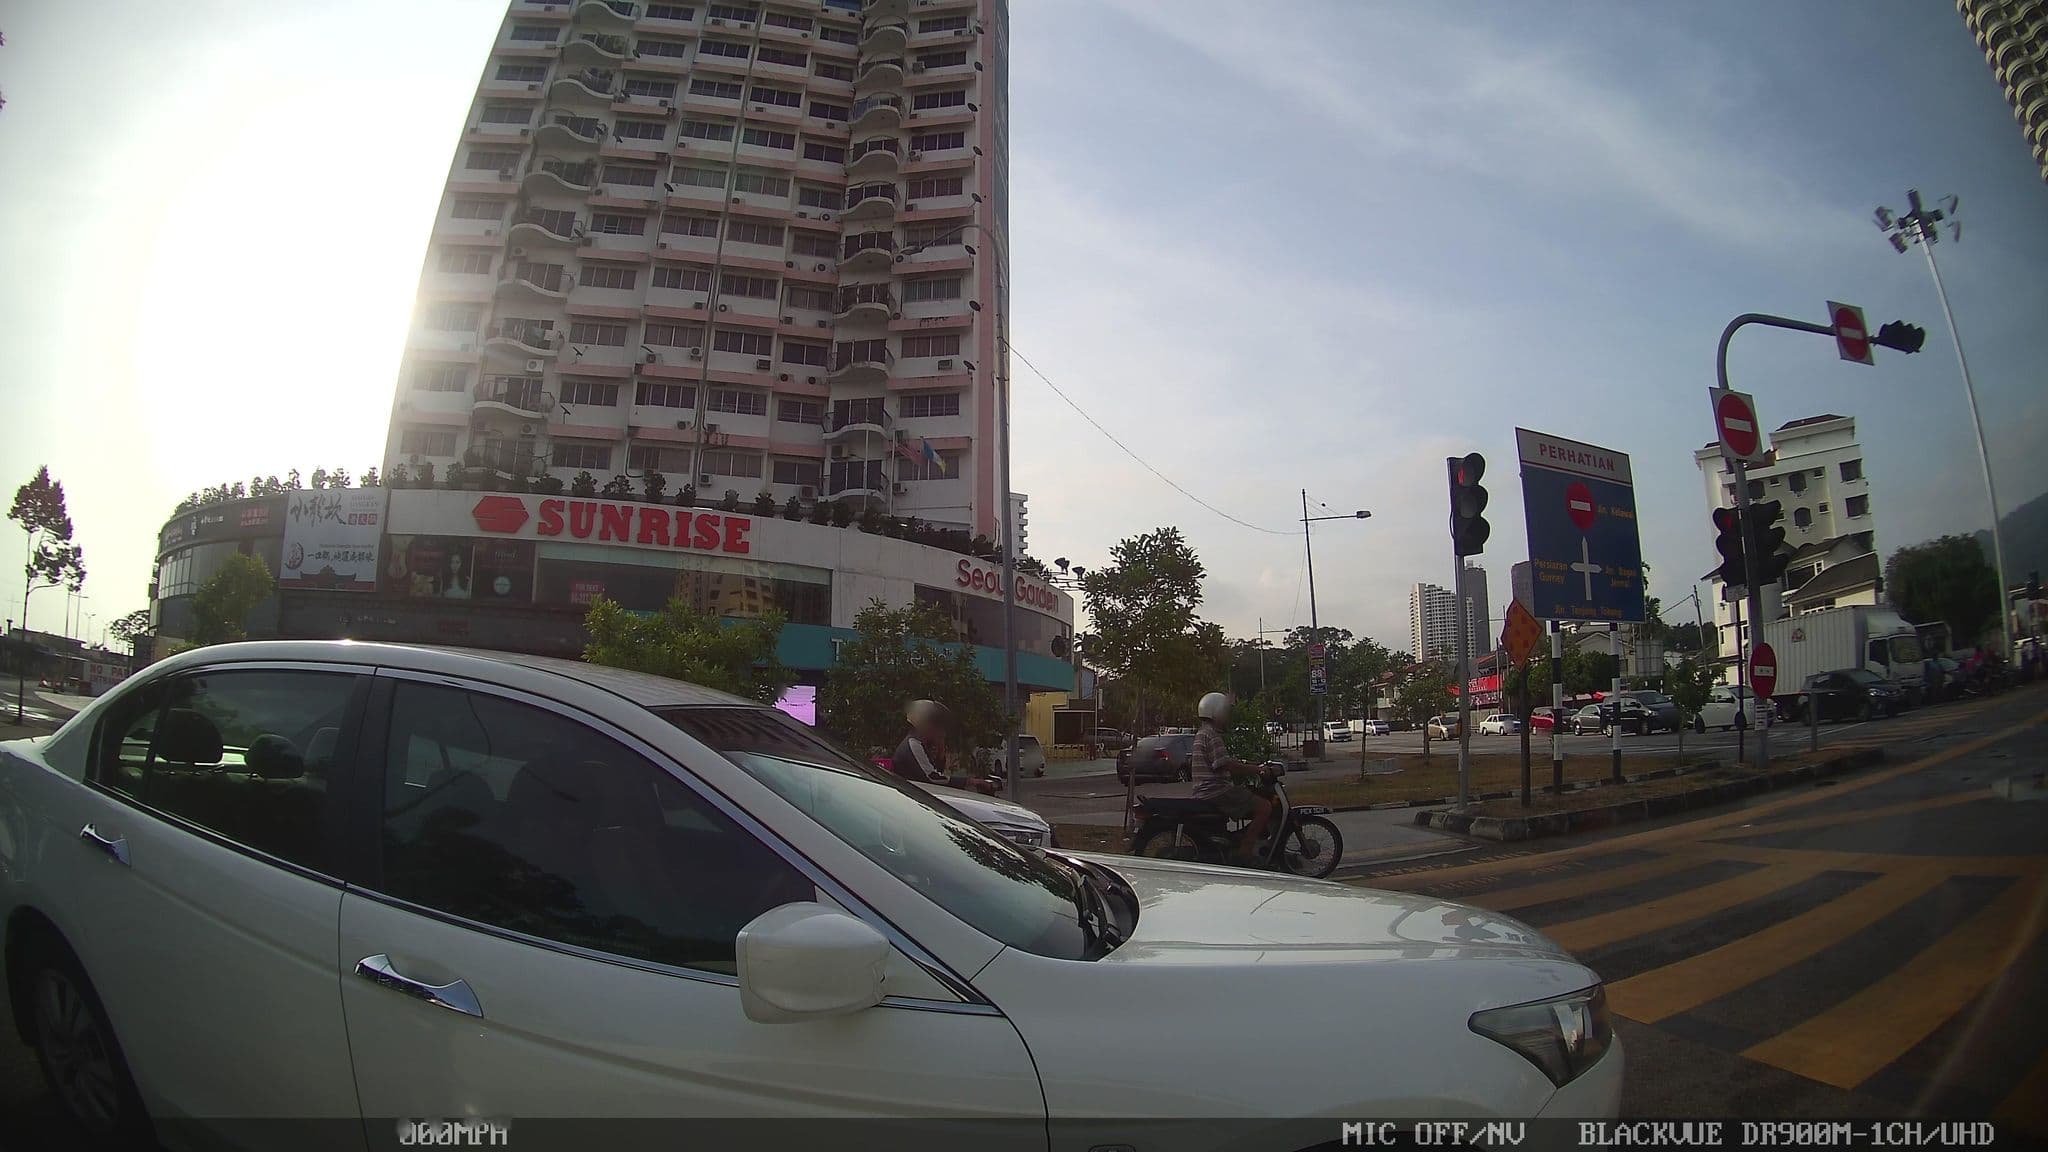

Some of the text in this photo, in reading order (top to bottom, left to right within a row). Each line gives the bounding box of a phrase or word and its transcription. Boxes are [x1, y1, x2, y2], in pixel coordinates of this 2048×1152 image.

[1538, 443, 1615, 471] PERHATIAN
[537, 499, 750, 554] SUNRISE
[1535, 558, 1568, 571] Persiaran
[1014, 575, 1059, 613] Garden
